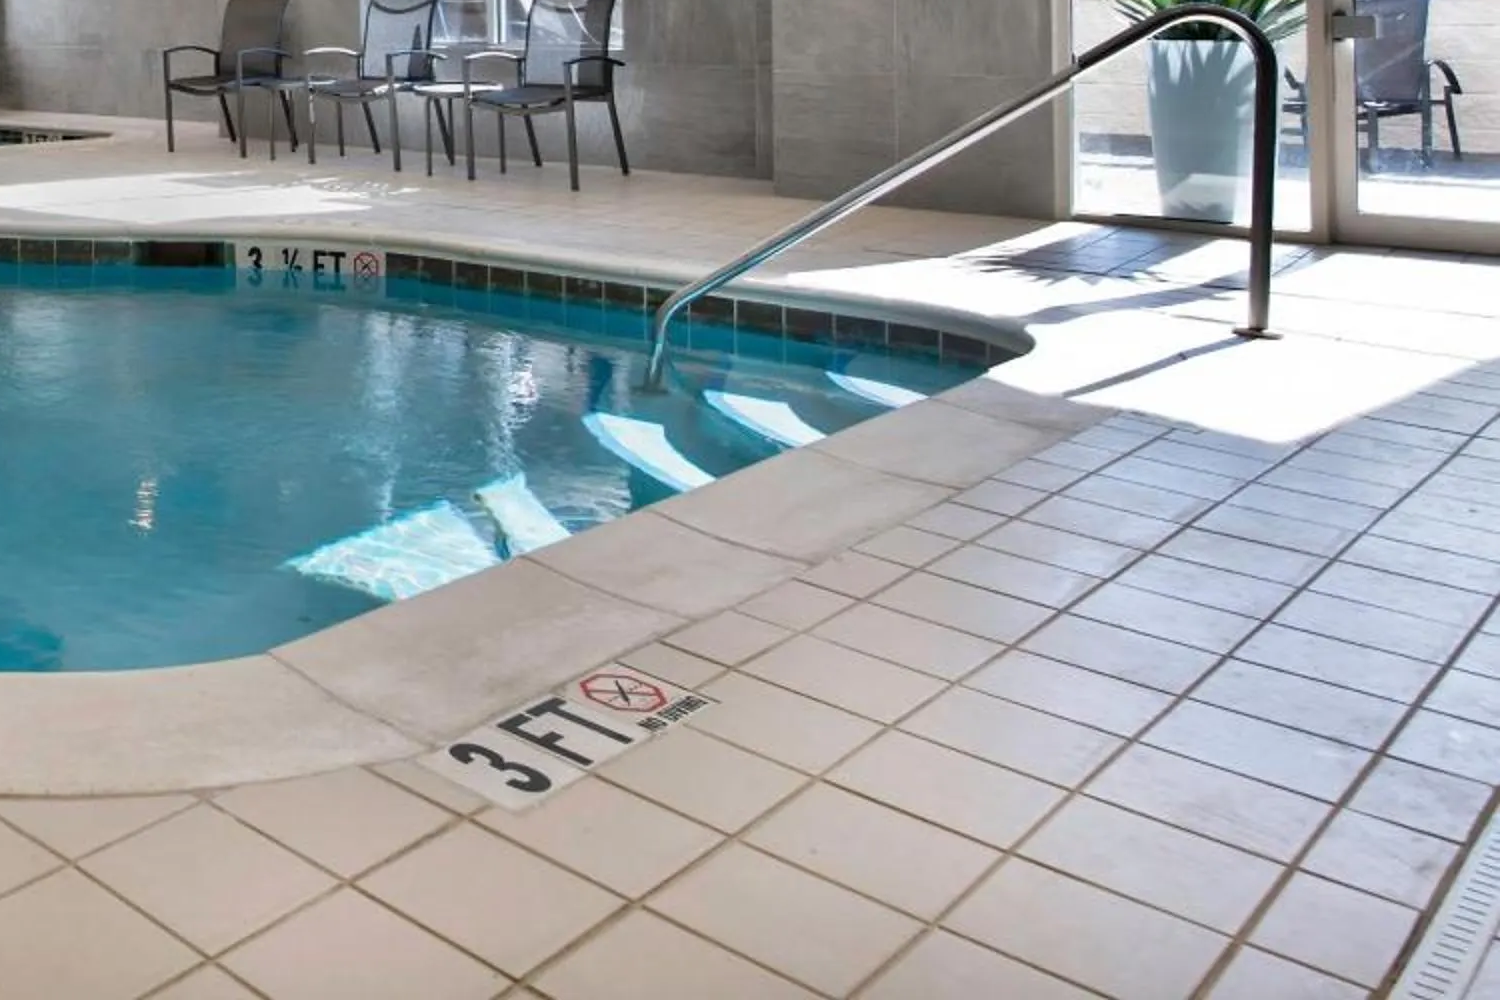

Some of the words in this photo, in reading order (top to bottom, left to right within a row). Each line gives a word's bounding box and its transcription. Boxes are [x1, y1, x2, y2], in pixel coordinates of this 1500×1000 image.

[248, 246, 262, 270] 3
[313, 250, 347, 272] FT
[497, 696, 634, 767] FT
[449, 743, 552, 794] 3
